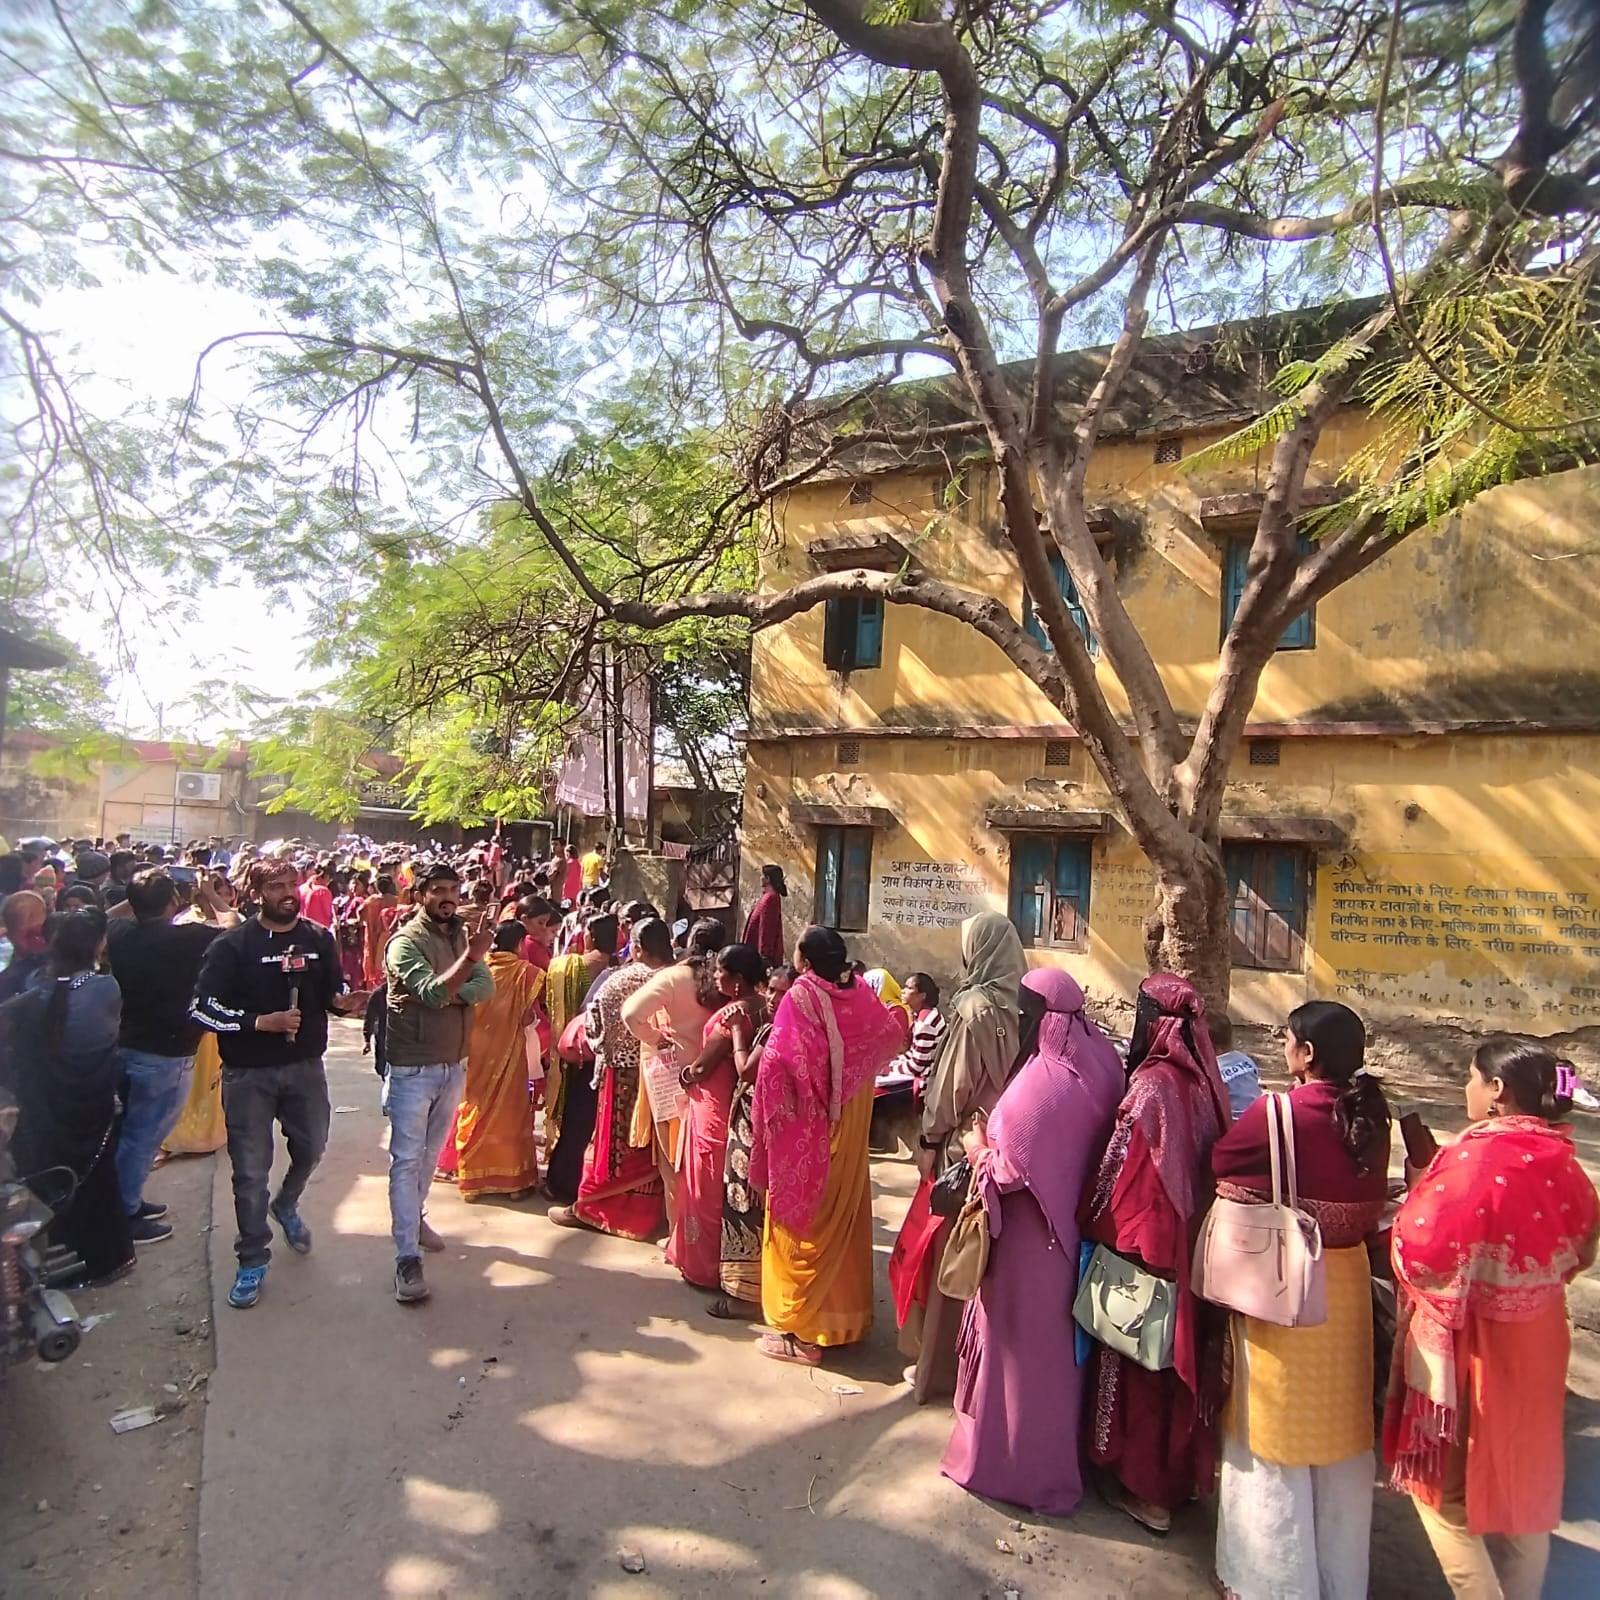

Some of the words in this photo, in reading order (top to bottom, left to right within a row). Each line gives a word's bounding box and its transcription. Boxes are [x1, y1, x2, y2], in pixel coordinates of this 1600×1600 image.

[912, 862, 930, 873] जन
[882, 876, 900, 888] ग्राम
[1333, 879, 1382, 895] अधिकतम
[1387, 885, 1412, 896] लाभ
[1415, 883, 1425, 896] के
[1464, 885, 1509, 900] किसान
[1515, 888, 1558, 902] विकास
[1566, 892, 1589, 905] पत्र
[1332, 899, 1376, 911] आयकर
[1422, 899, 1434, 914] के
[1472, 903, 1499, 917] लोक
[1331, 912, 1369, 927] नियमित
[1371, 917, 1396, 929] लाभ
[1398, 916, 1409, 929] के
[1440, 918, 1476, 933] मासिक
[1478, 922, 1500, 935] आय
[1503, 920, 1543, 937] योजना
[1330, 929, 1368, 944] वरिष्ठ
[1372, 931, 1422, 947] नागरिक
[1425, 933, 1440, 947] के
[1520, 940, 1574, 957] नागरिक
